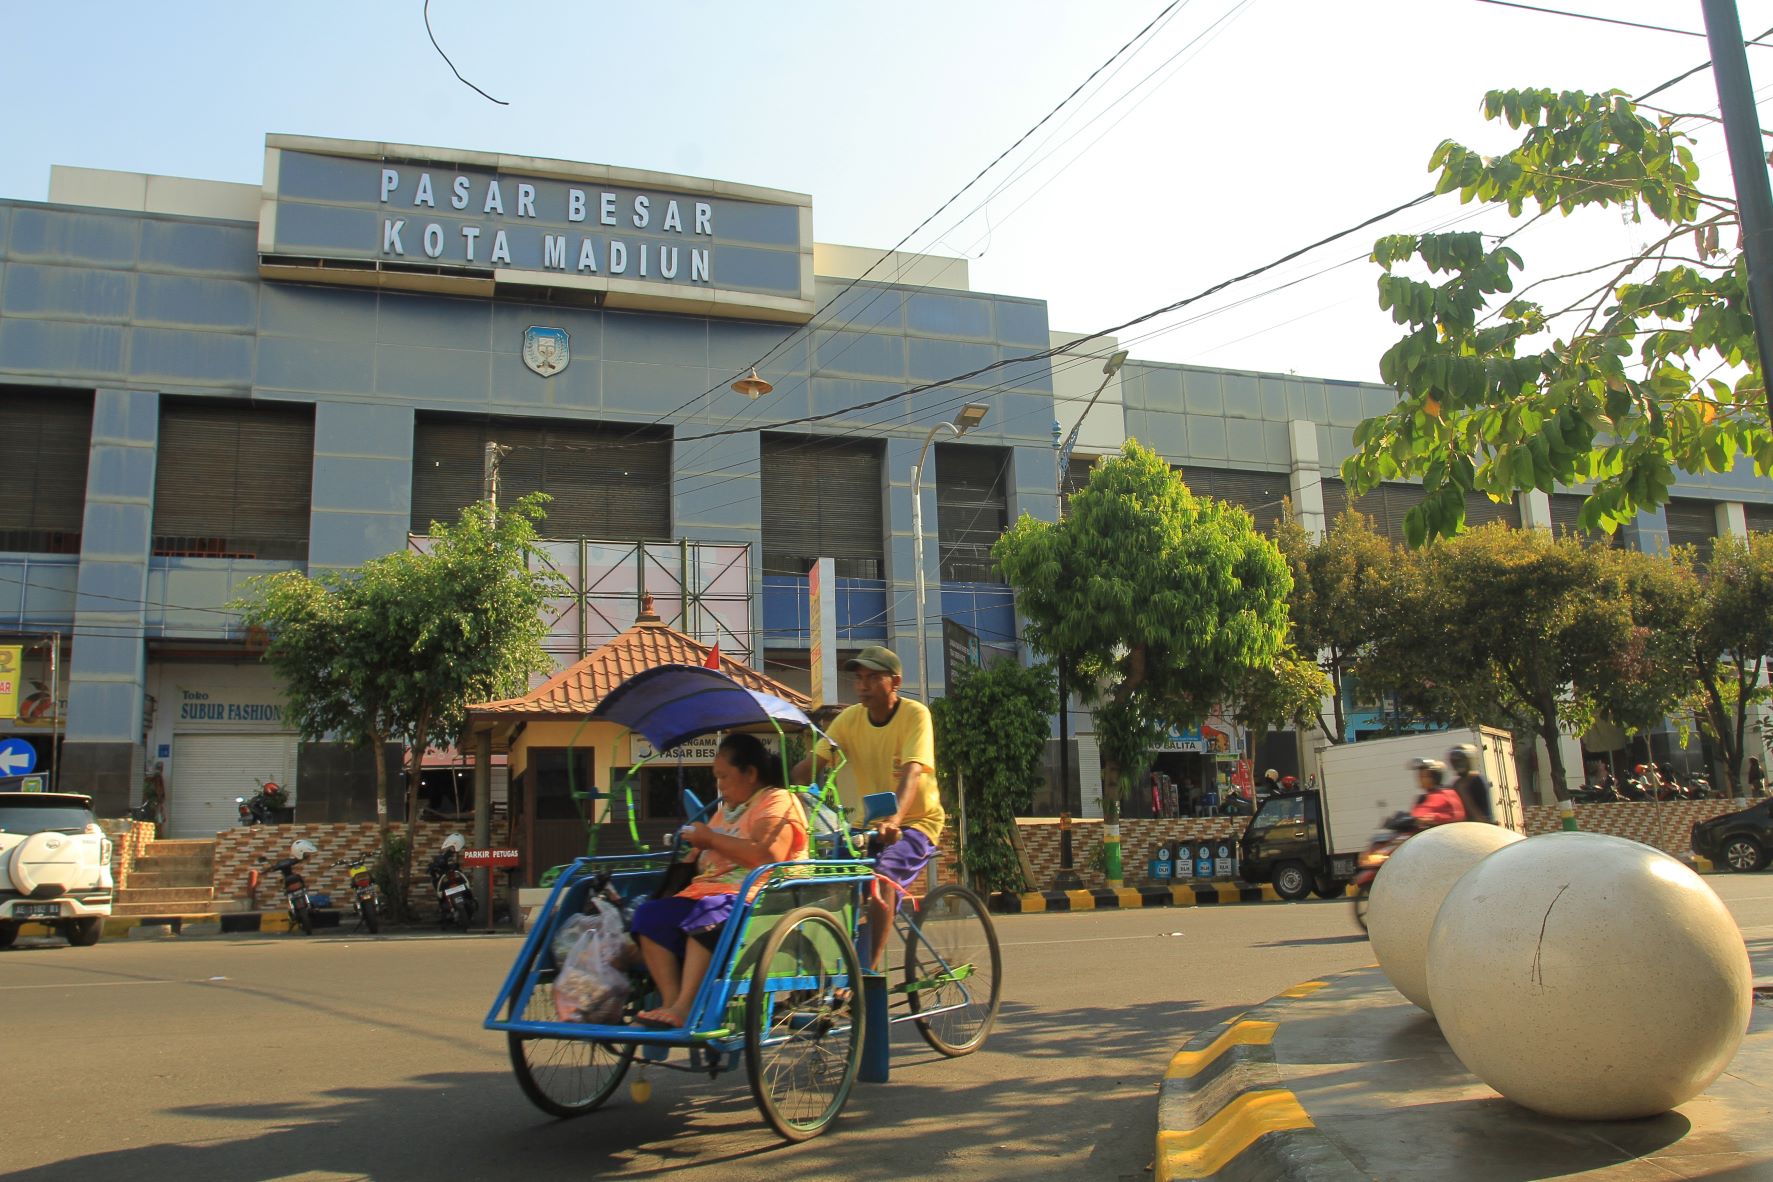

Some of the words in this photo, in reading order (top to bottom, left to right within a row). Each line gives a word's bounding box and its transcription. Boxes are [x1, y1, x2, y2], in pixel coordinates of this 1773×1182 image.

[380, 168, 537, 218] PASAR
[568, 188, 713, 236] BESAR
[383, 218, 512, 265] KOTA
[543, 234, 710, 282] MADIUN
[183, 690, 209, 700] Toko
[181, 703, 225, 720] SUBUR
[228, 704, 282, 721] FASHION
[696, 749, 719, 758] BES
[464, 850, 490, 858] PARKIR
[492, 849, 518, 858] PETUGAS
